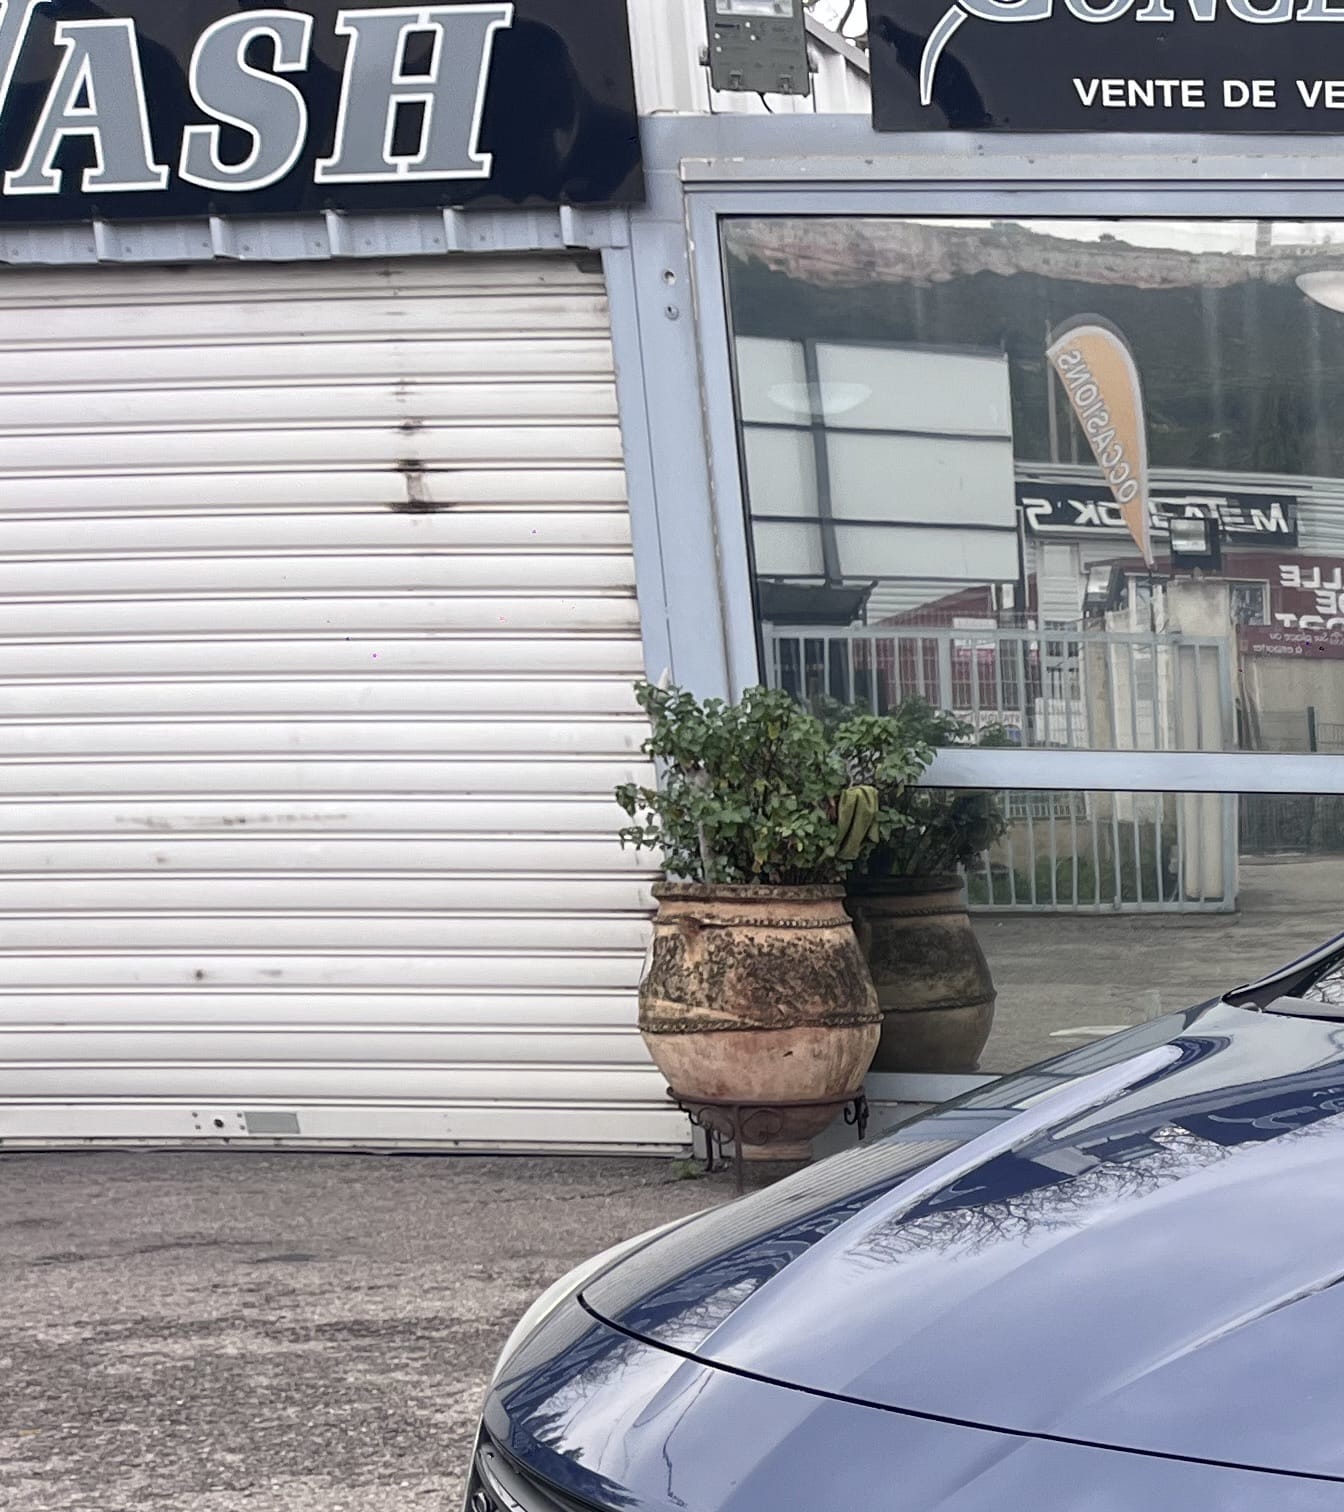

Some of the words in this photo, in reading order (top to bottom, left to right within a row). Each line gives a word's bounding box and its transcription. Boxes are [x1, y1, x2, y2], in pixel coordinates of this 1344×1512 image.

[0, 0, 514, 195] ASH
[1073, 78, 1205, 108] VENTE
[1223, 79, 1276, 109] DE
